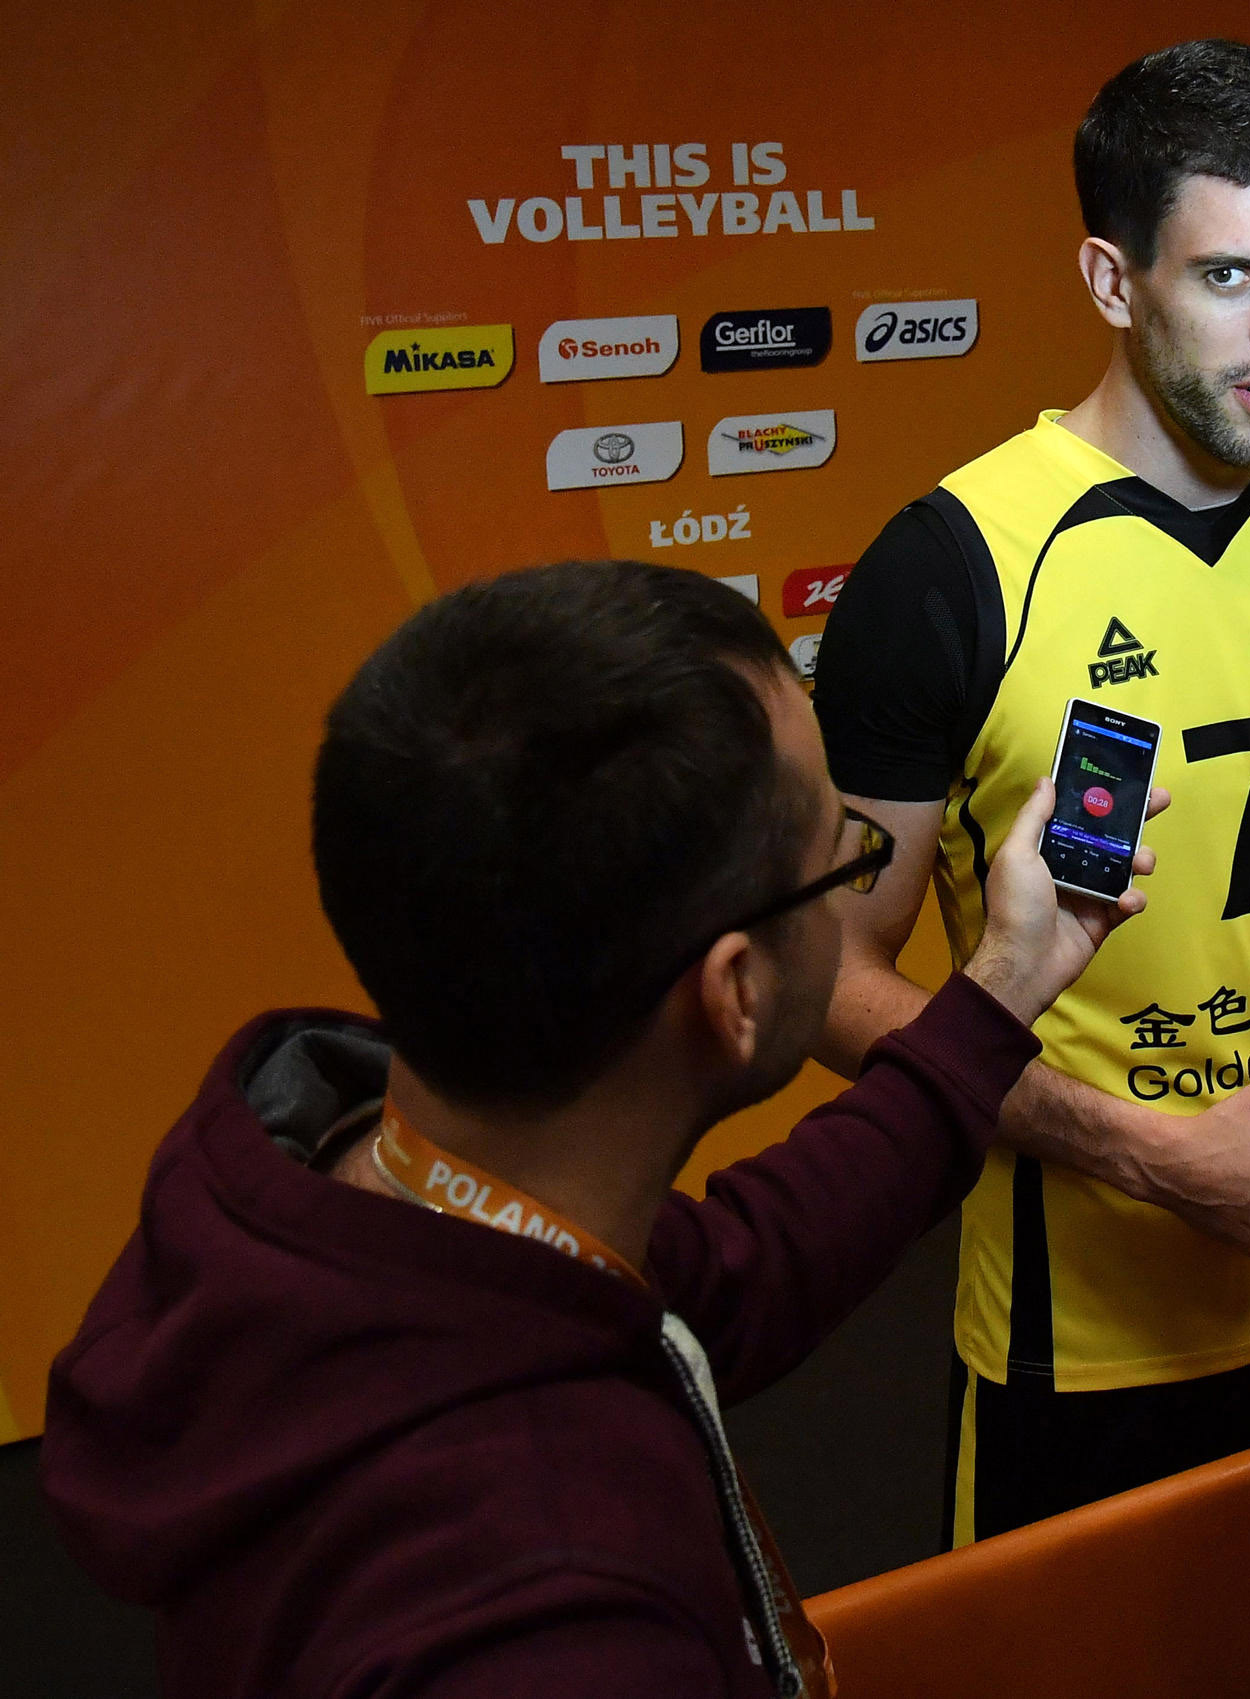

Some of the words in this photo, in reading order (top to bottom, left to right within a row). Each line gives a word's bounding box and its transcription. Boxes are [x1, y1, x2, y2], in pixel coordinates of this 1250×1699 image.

[561, 143, 710, 190] THIS
[731, 142, 787, 187] IS
[466, 189, 876, 244] VOLLEYBALL
[715, 320, 796, 345] Gerflor
[582, 337, 660, 360] Senoh
[738, 426, 787, 440] BLACHY
[591, 465, 640, 478] TOYOTA
[649, 505, 752, 548] ŁÓDŹ
[1088, 650, 1160, 690] PEAK
[1105, 716, 1126, 727] SONY
[1087, 794, 1109, 809] 00:28
